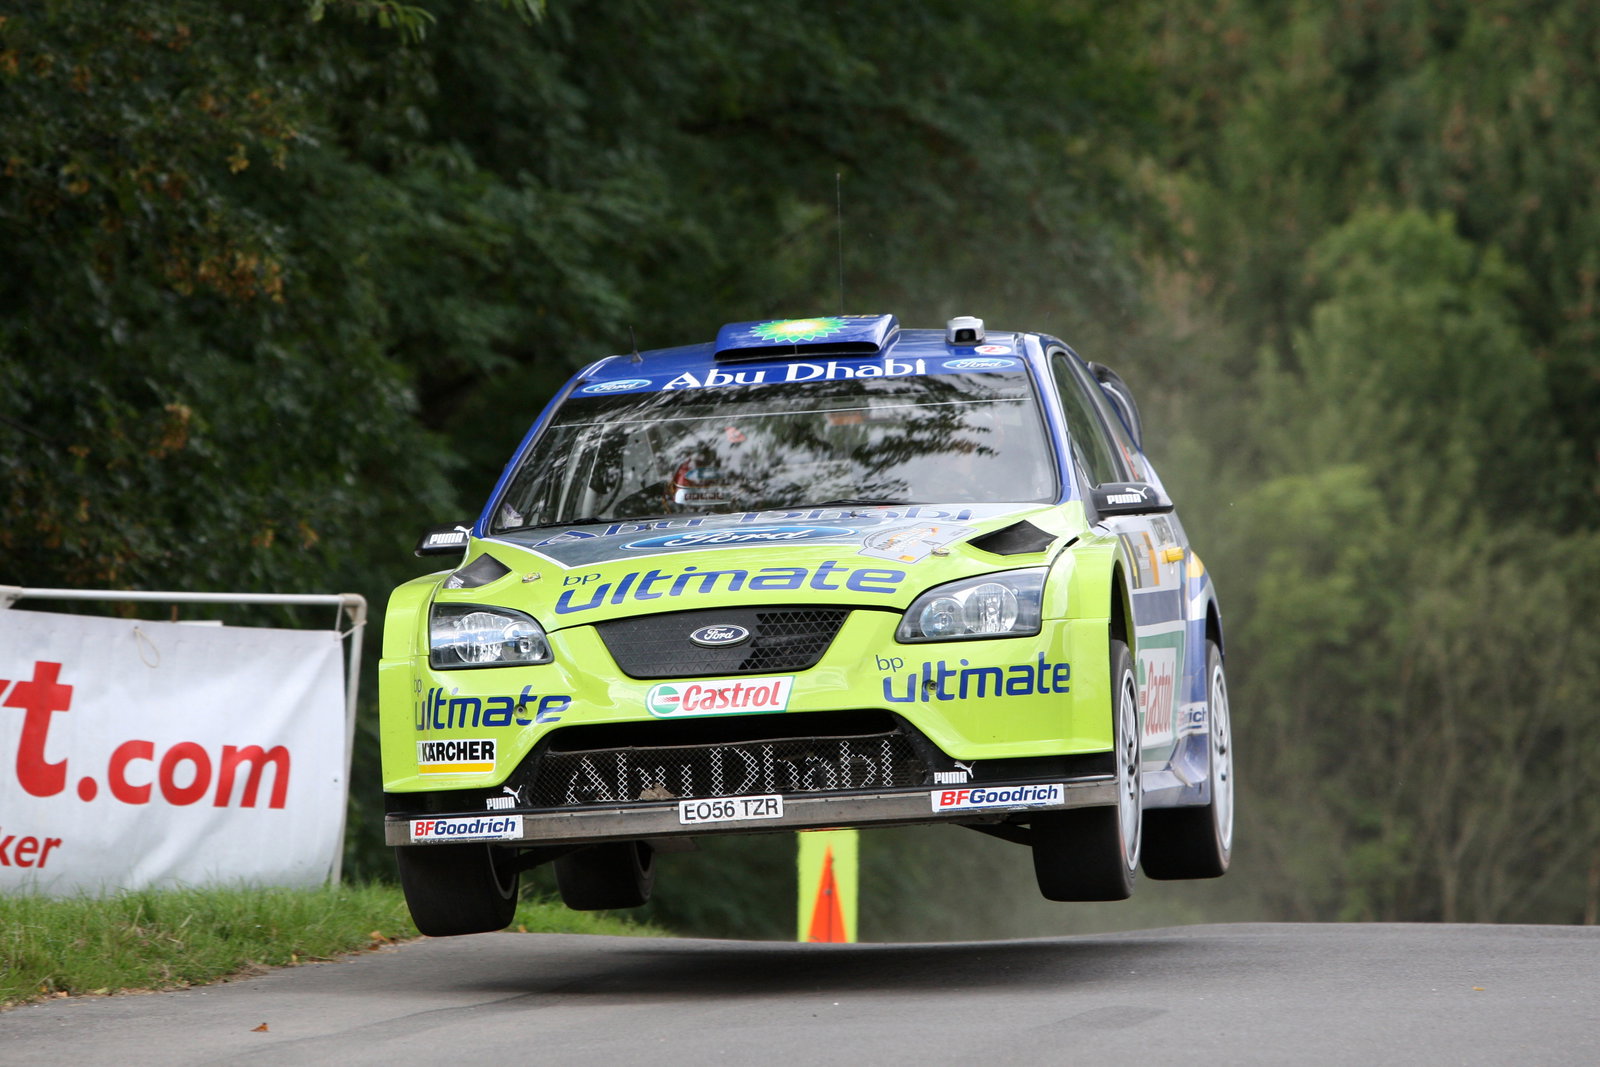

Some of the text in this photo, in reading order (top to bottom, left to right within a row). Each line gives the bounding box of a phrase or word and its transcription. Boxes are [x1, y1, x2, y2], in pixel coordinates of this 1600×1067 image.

[662, 357, 926, 391] Abu Dhabi
[1106, 493, 1143, 505] PUMA
[429, 532, 465, 545] PUMA
[664, 526, 818, 548] Ford
[554, 560, 906, 615] ultimate
[563, 572, 602, 587] bp
[703, 626, 736, 642] Ford
[876, 654, 904, 673] bp
[882, 650, 1071, 703] ultimate
[415, 684, 572, 731] ultimate
[685, 680, 781, 713] Castrol
[0, 660, 291, 810] t.com
[421, 740, 495, 763] KÄRCHER
[710, 739, 894, 798] Dhabi
[933, 770, 968, 784] PUMA
[486, 797, 516, 810] PUMA
[939, 785, 1059, 808] BFGoodrich
[683, 797, 779, 821] EO56 TZR
[414, 818, 517, 837] BFGoodrich
